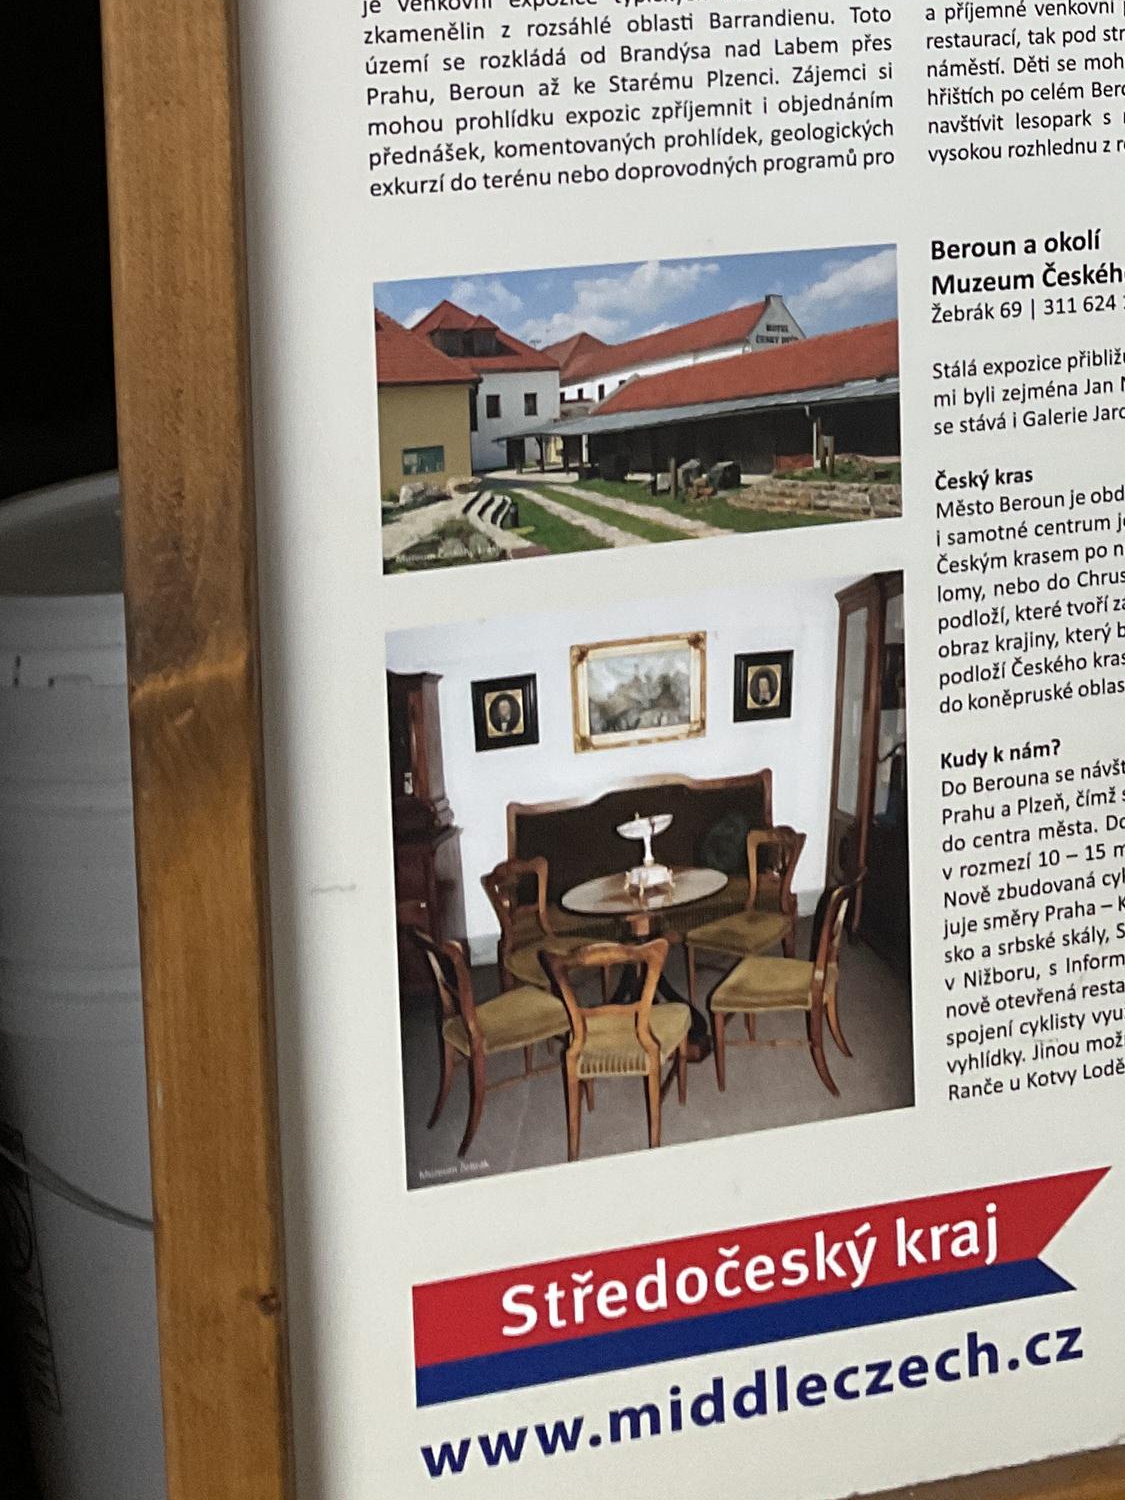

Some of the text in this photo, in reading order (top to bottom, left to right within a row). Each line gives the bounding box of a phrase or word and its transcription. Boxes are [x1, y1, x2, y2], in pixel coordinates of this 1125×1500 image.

[927, 142, 1002, 167] vysokou
[1008, 137, 1097, 159] rozhlednu
[1102, 139, 1111, 153] z
[370, 147, 895, 197] exkurzí do terénu nebo doprovodných programů pro
[931, 228, 1102, 261] Beroun a okolí
[932, 273, 1035, 296] Muzeum
[931, 301, 995, 324] Žebrák
[1000, 300, 1022, 319] 69
[1043, 296, 1077, 316] 311
[1083, 293, 1117, 313] 624
[932, 358, 977, 380] Stálá
[983, 354, 1062, 378] expozice
[935, 467, 1033, 492] Český kras
[940, 738, 1061, 770] Kudy k nám?
[948, 1077, 1004, 1102] Ranče
[1009, 1077, 1020, 1092] u
[1027, 1068, 1077, 1090] Kotvy
[501, 1202, 998, 1337] Středočeský kraj
[421, 1327, 1084, 1478] www.middleczech.cz
